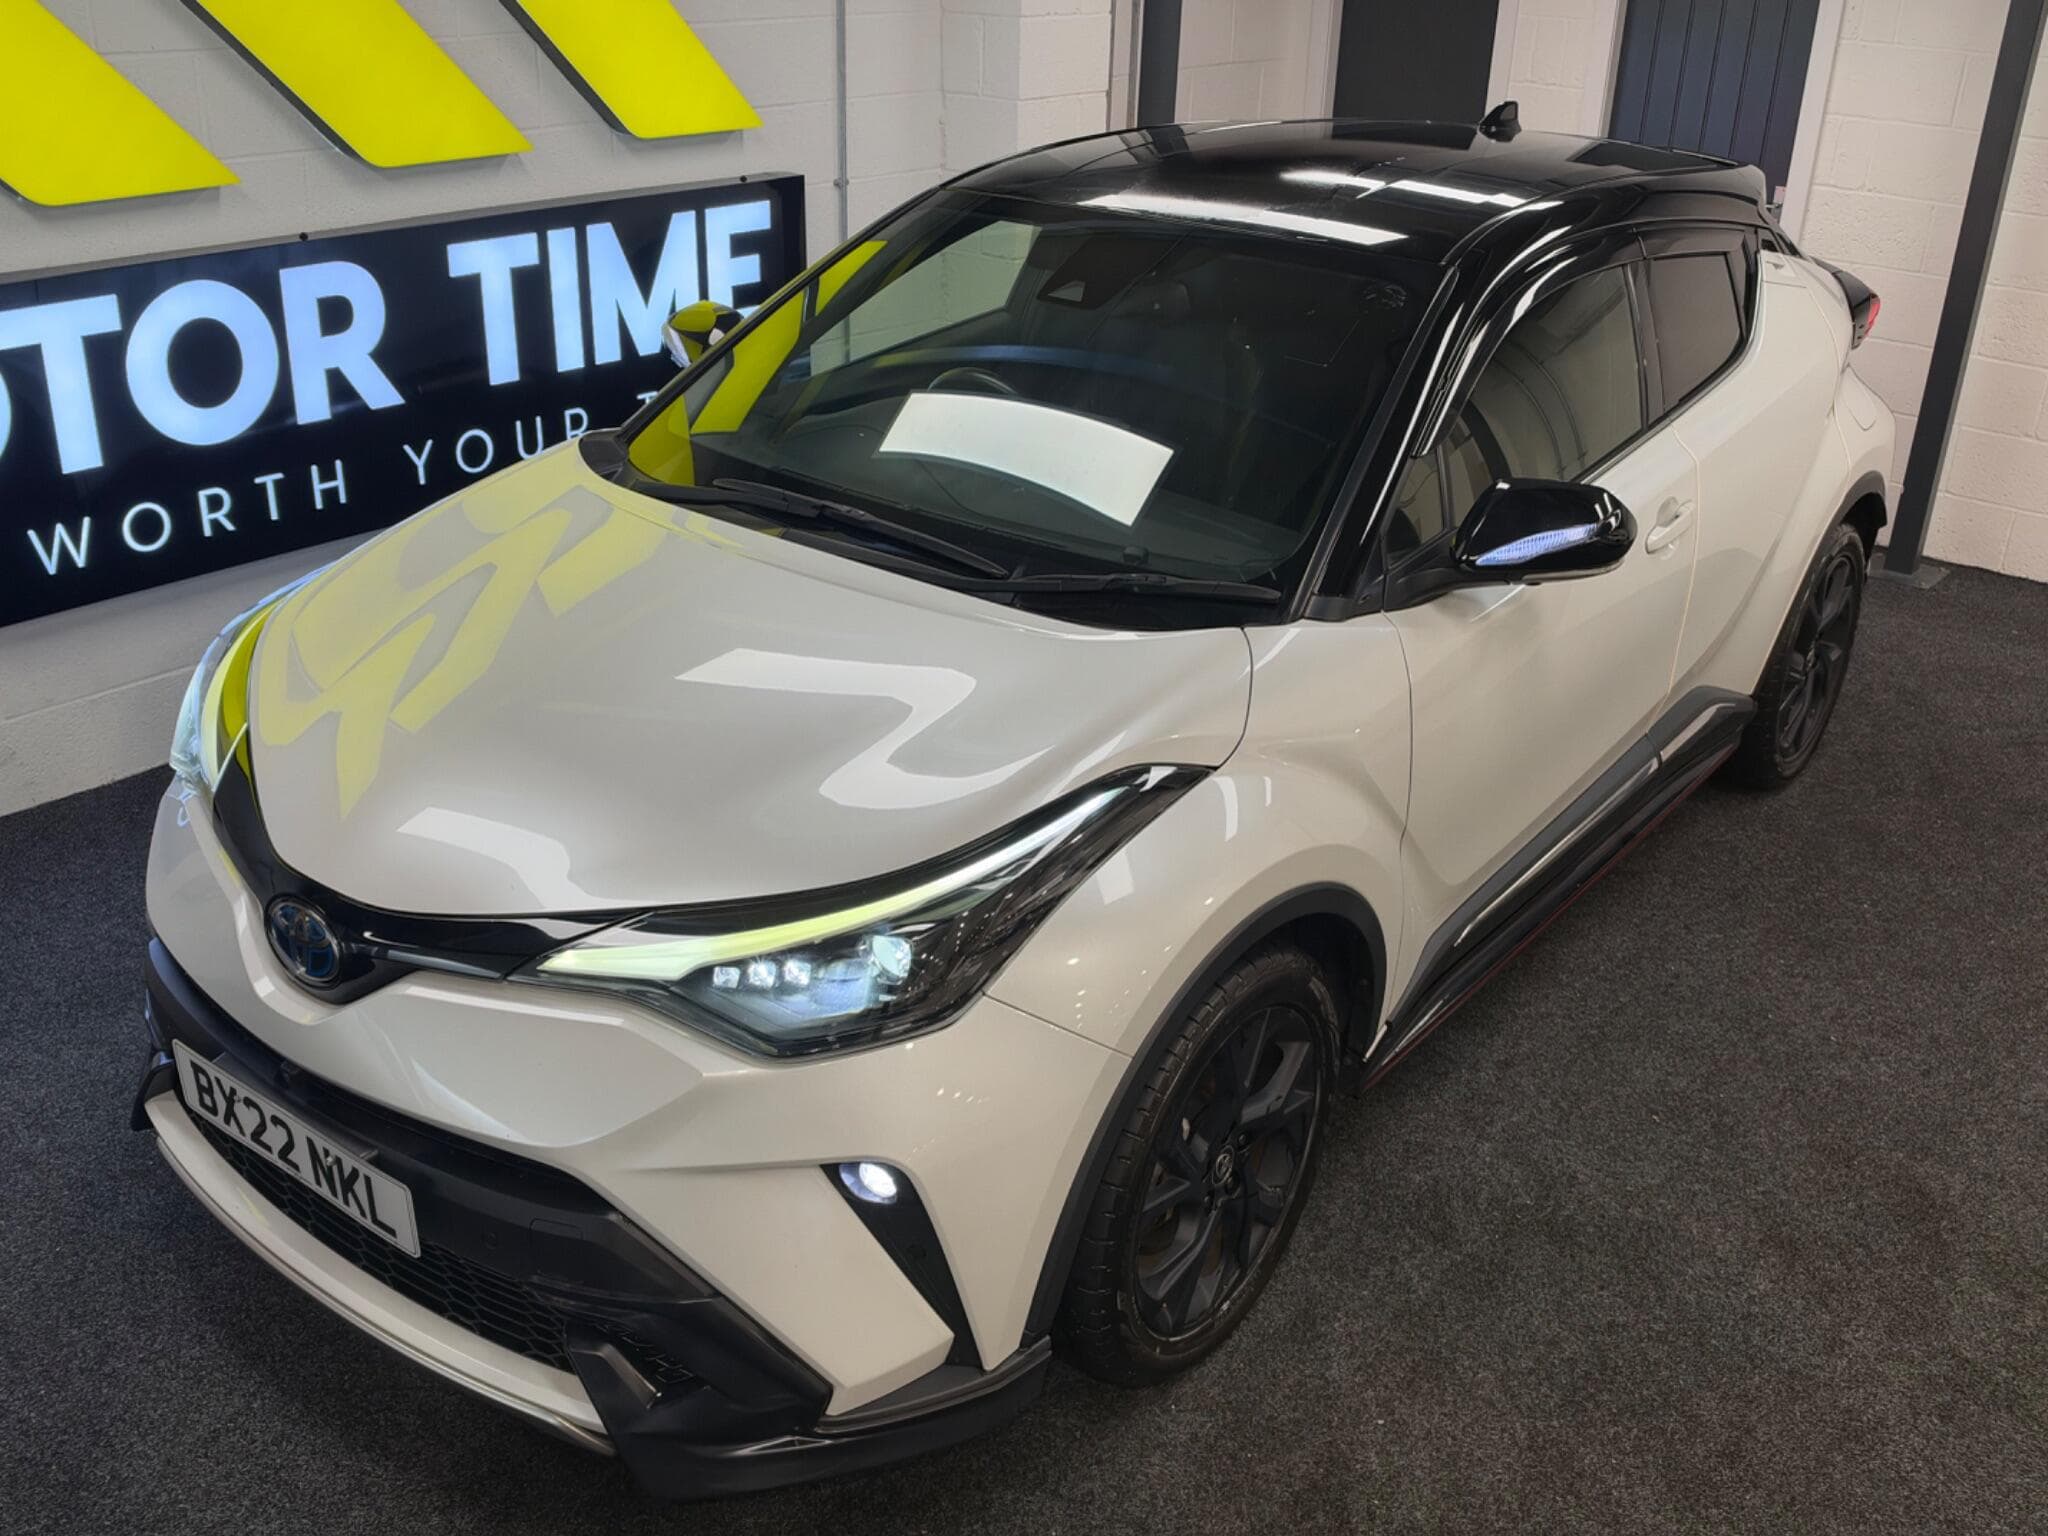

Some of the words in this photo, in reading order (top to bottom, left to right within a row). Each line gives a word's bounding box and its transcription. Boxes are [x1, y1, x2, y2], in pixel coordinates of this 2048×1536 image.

[0, 260, 405, 475] TOR
[446, 199, 771, 386] TIME
[27, 459, 349, 576] WORTH
[404, 407, 589, 485] YOUR
[190, 1059, 300, 1173] BX22
[305, 1135, 398, 1239] NKL
